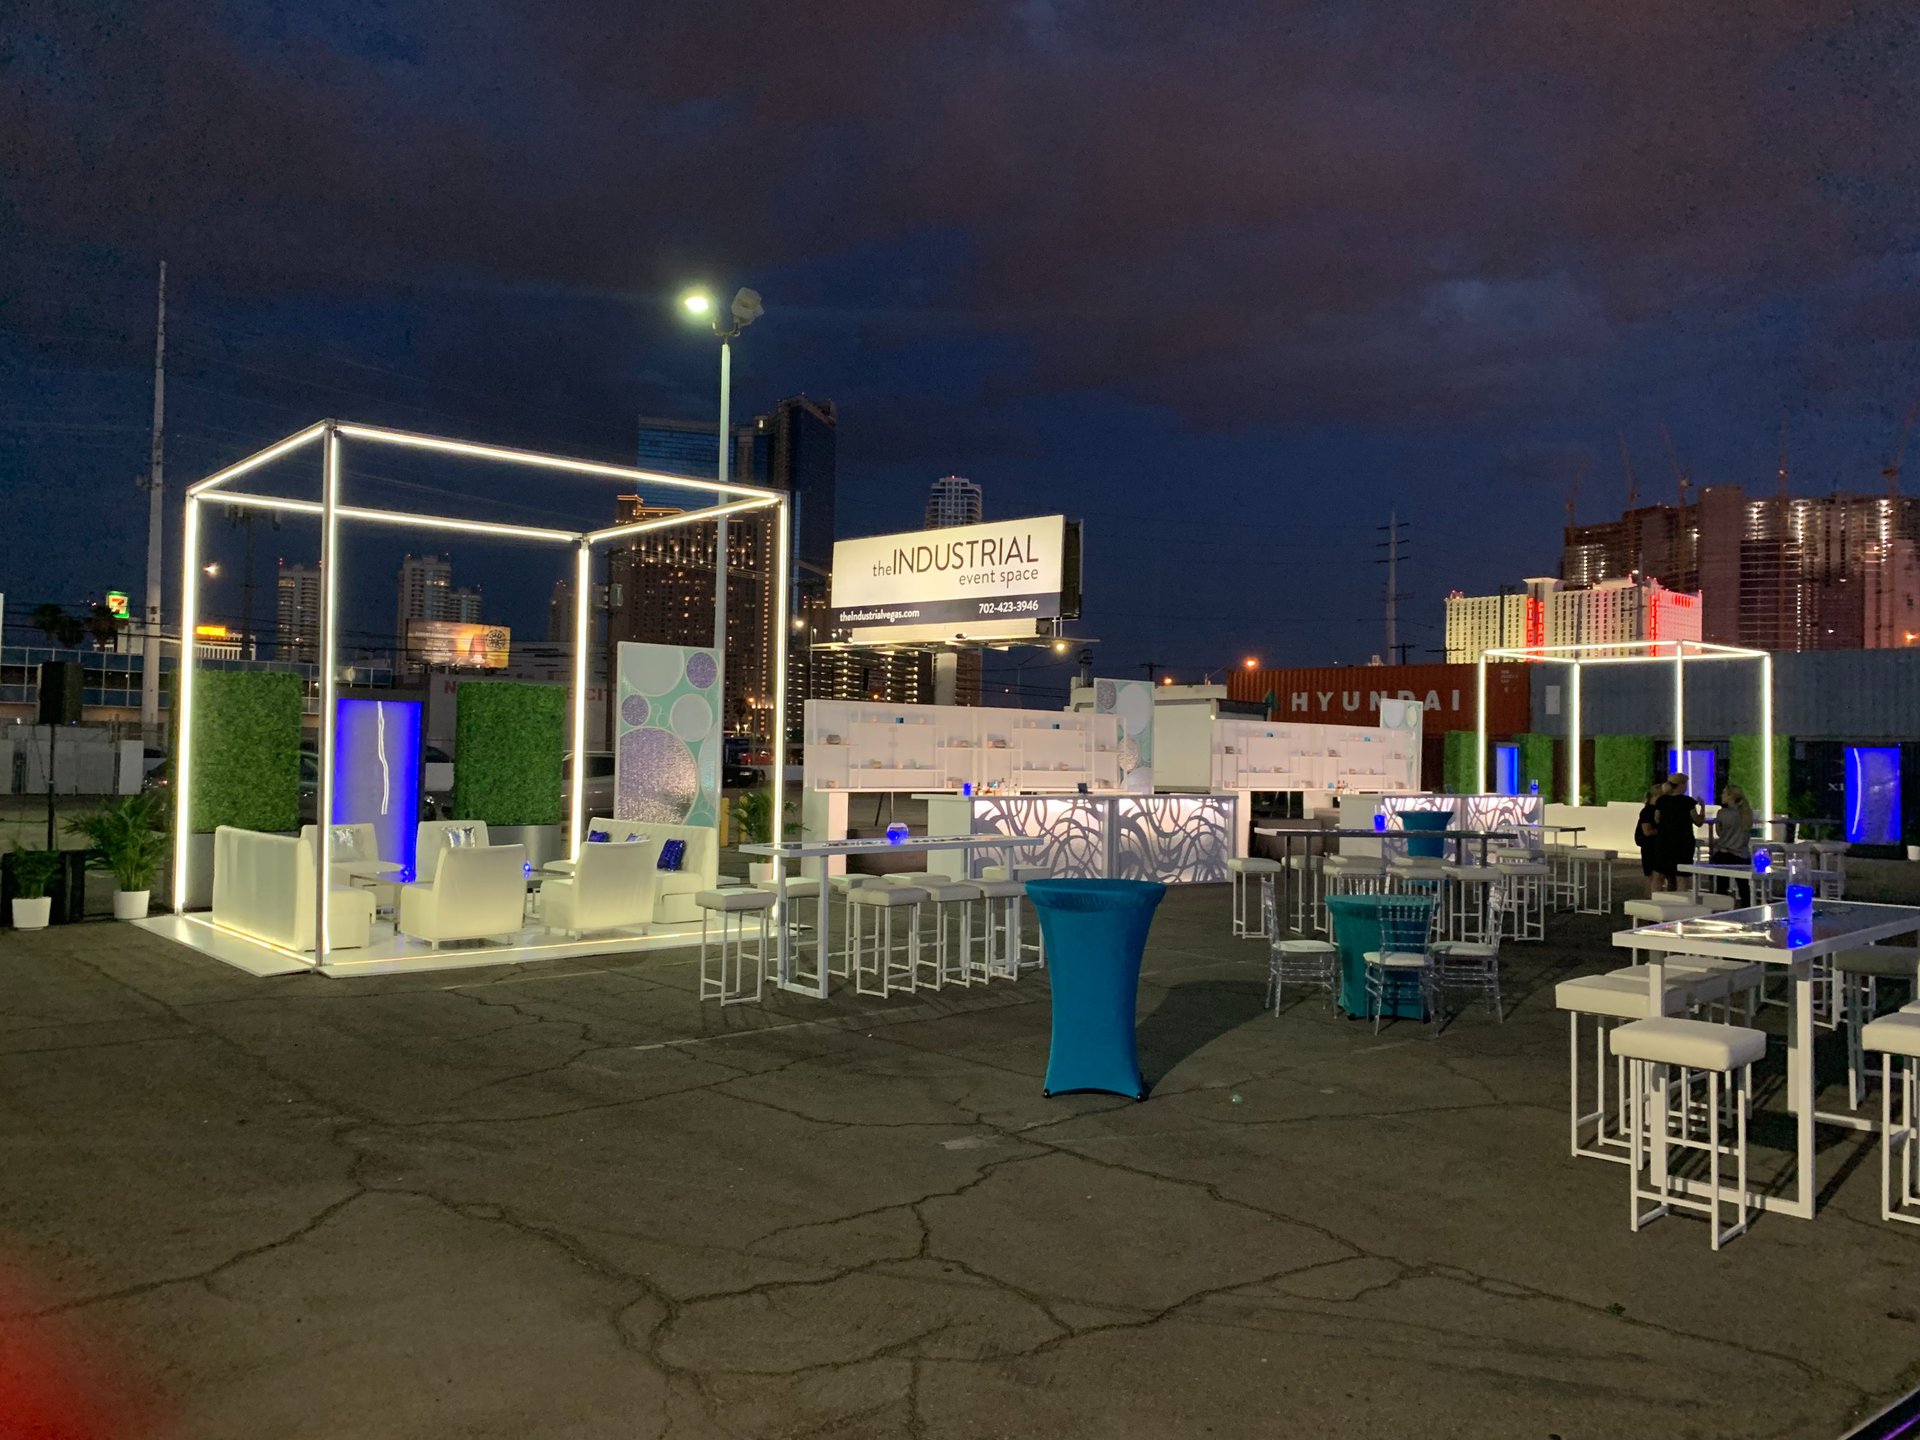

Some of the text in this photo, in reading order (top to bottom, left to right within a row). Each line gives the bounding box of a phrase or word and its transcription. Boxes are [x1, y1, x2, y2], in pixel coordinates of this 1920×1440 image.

[959, 568, 1039, 589] event space
[978, 600, 1039, 614] 702-423-3946
